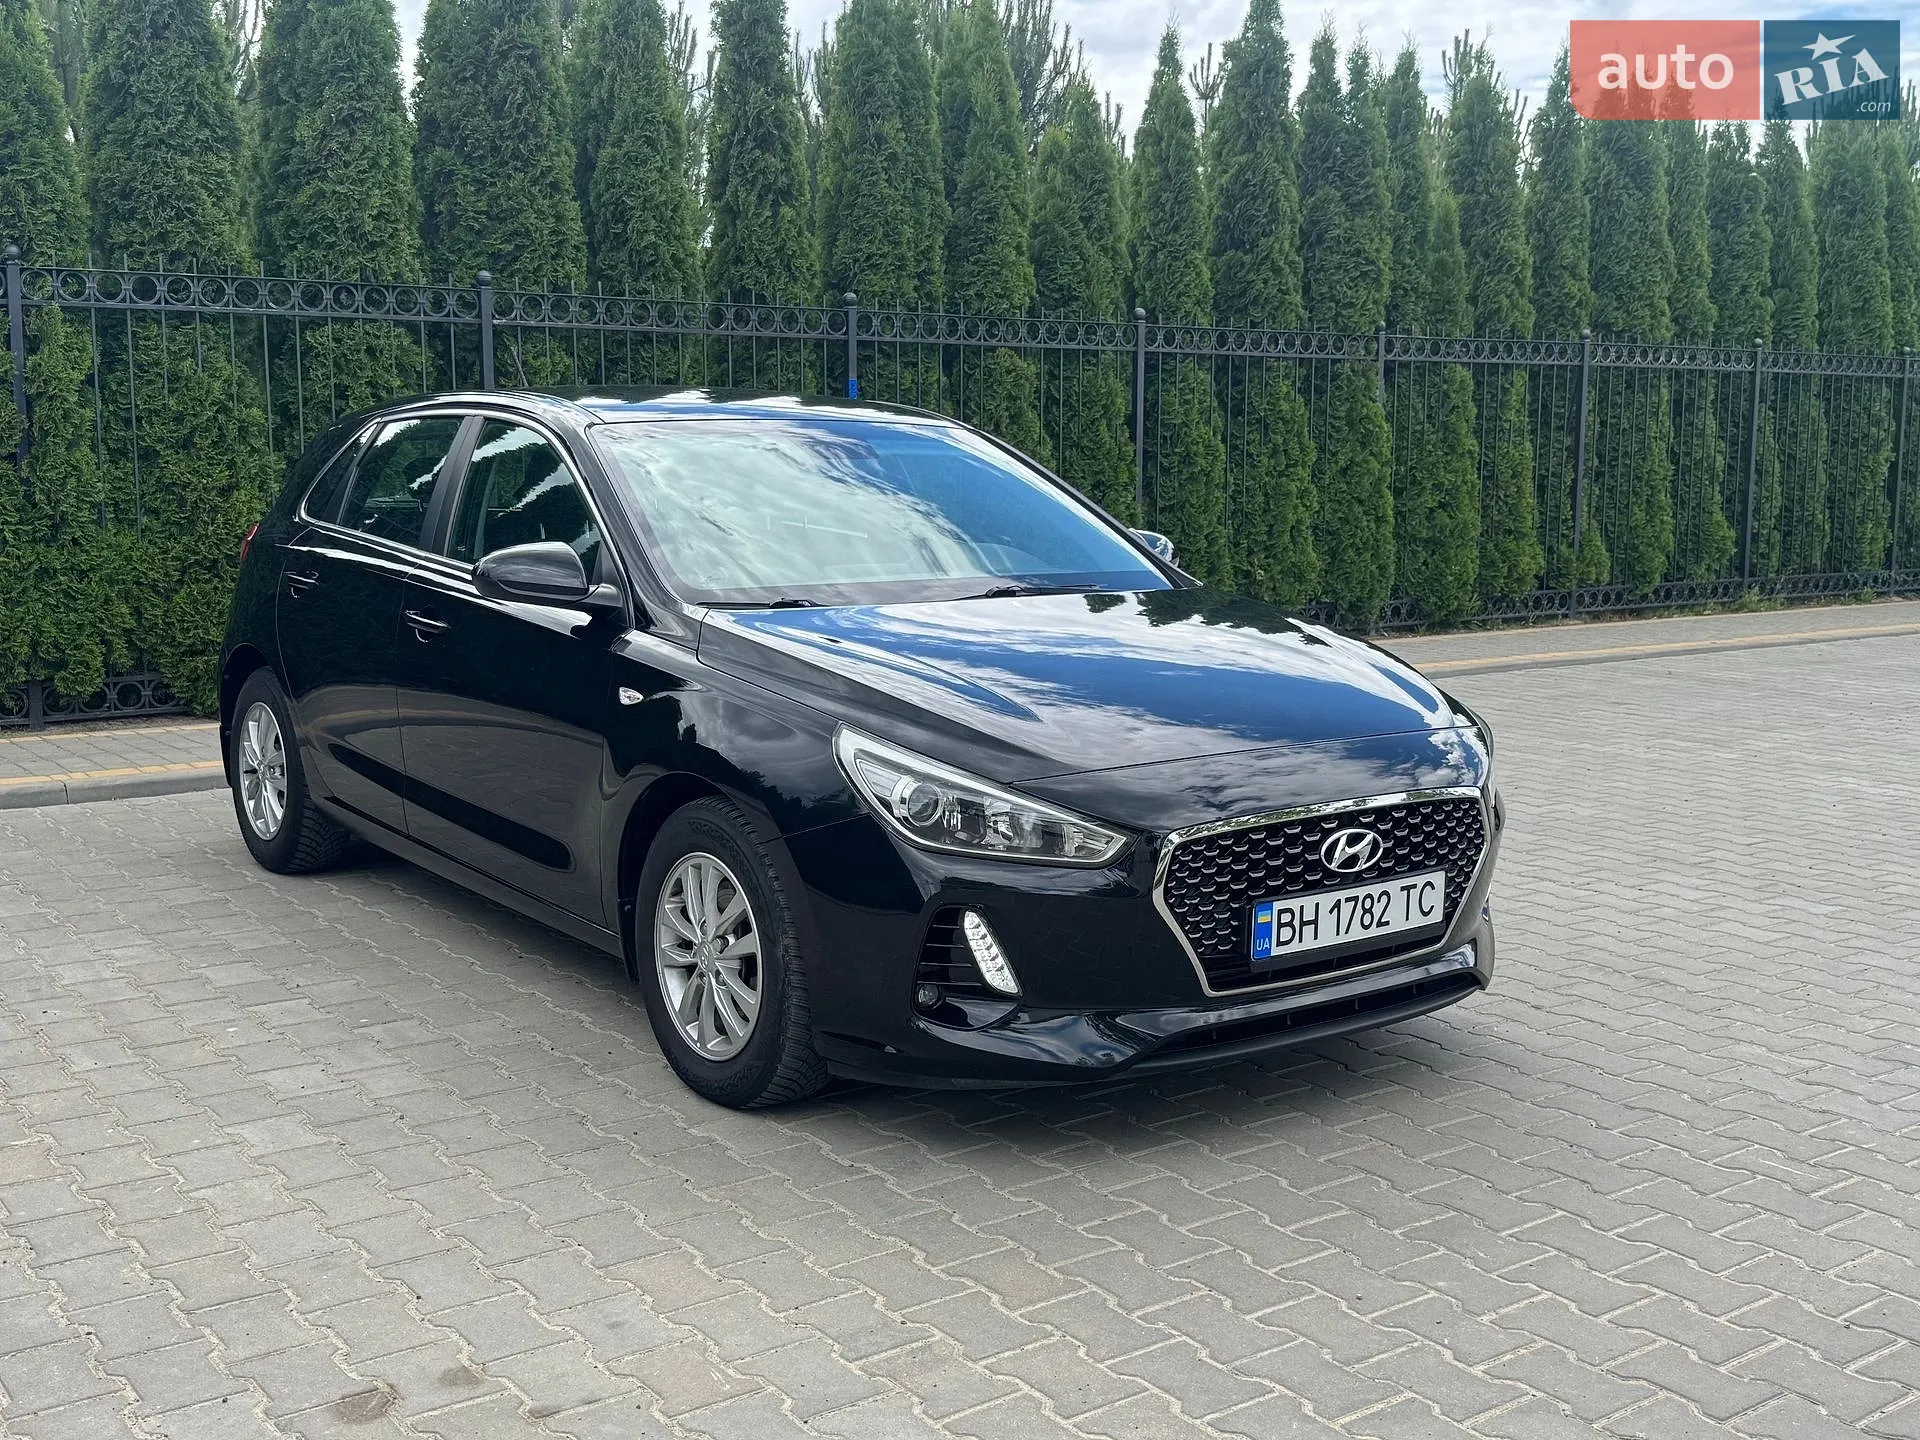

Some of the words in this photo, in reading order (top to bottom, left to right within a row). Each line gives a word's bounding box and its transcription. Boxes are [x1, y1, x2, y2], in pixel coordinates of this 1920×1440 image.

[1275, 901, 1320, 948] BH
[1328, 889, 1392, 937] 1782
[1400, 880, 1436, 922] TC
[1256, 937, 1270, 951] UA
